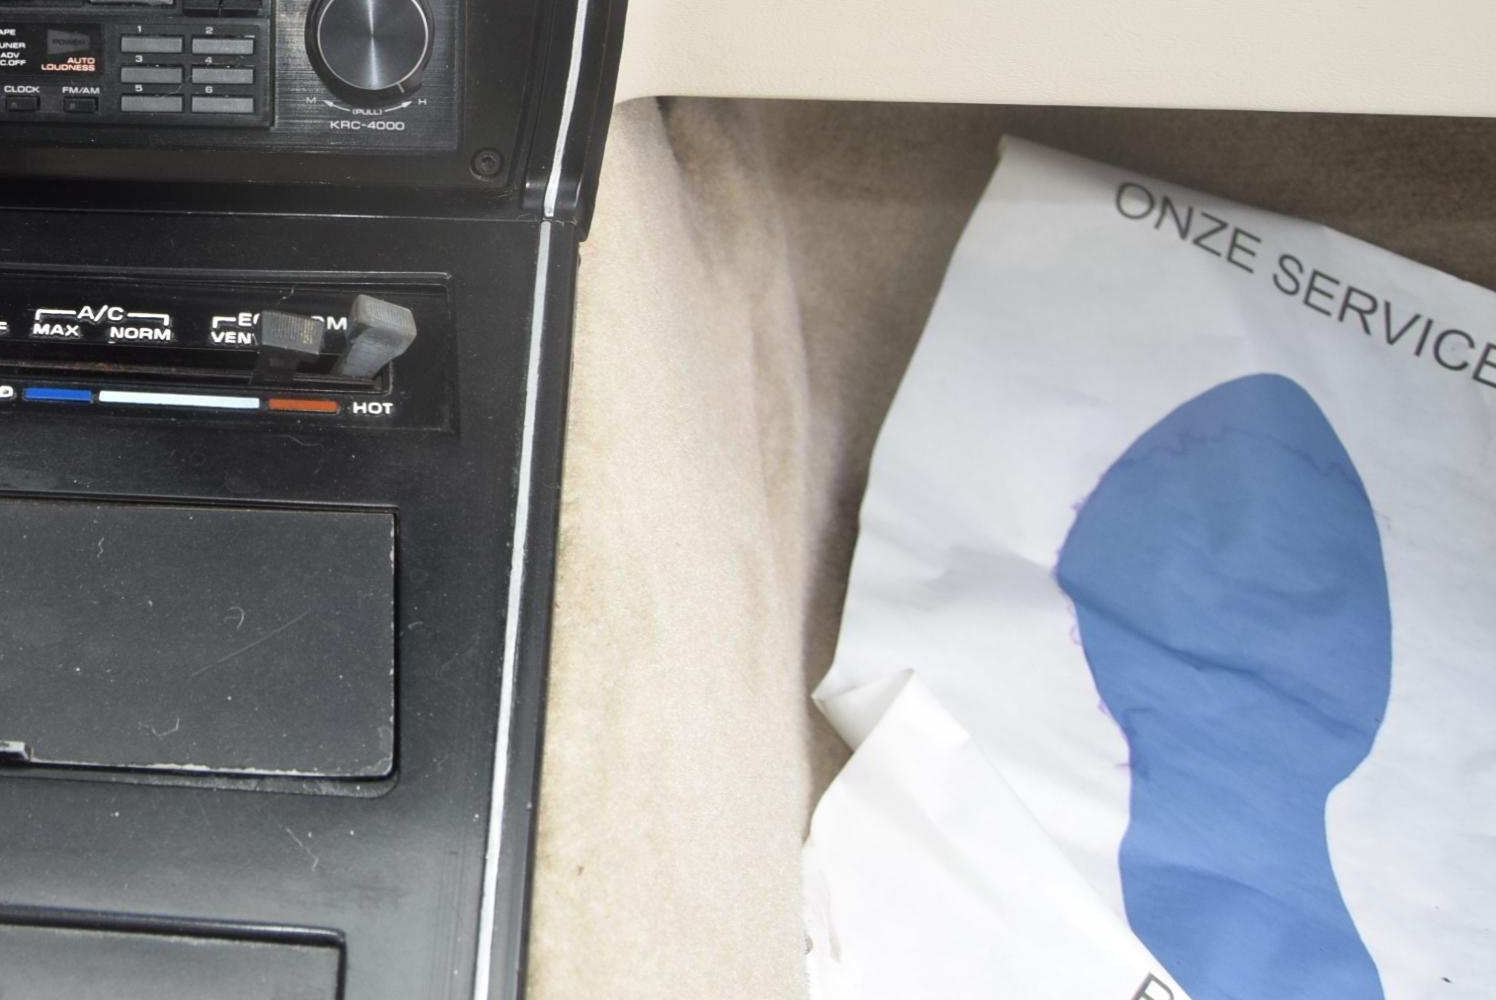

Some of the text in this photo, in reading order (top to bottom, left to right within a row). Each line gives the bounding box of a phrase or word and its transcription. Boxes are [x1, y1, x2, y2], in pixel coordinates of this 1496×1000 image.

[135, 55, 143, 63] 3
[205, 56, 212, 64] 4
[4, 85, 40, 93] CLOCK
[62, 86, 100, 95] FM/AM
[135, 84, 143, 92] 5
[205, 86, 213, 94] 6
[330, 120, 406, 130] KRC-4000
[1115, 182, 1496, 388] ONZE SERVICE
[77, 305, 125, 321] A/C
[33, 323, 171, 341] MAX NORM
[211, 331, 256, 345] VEN
[352, 402, 393, 415] HOT
